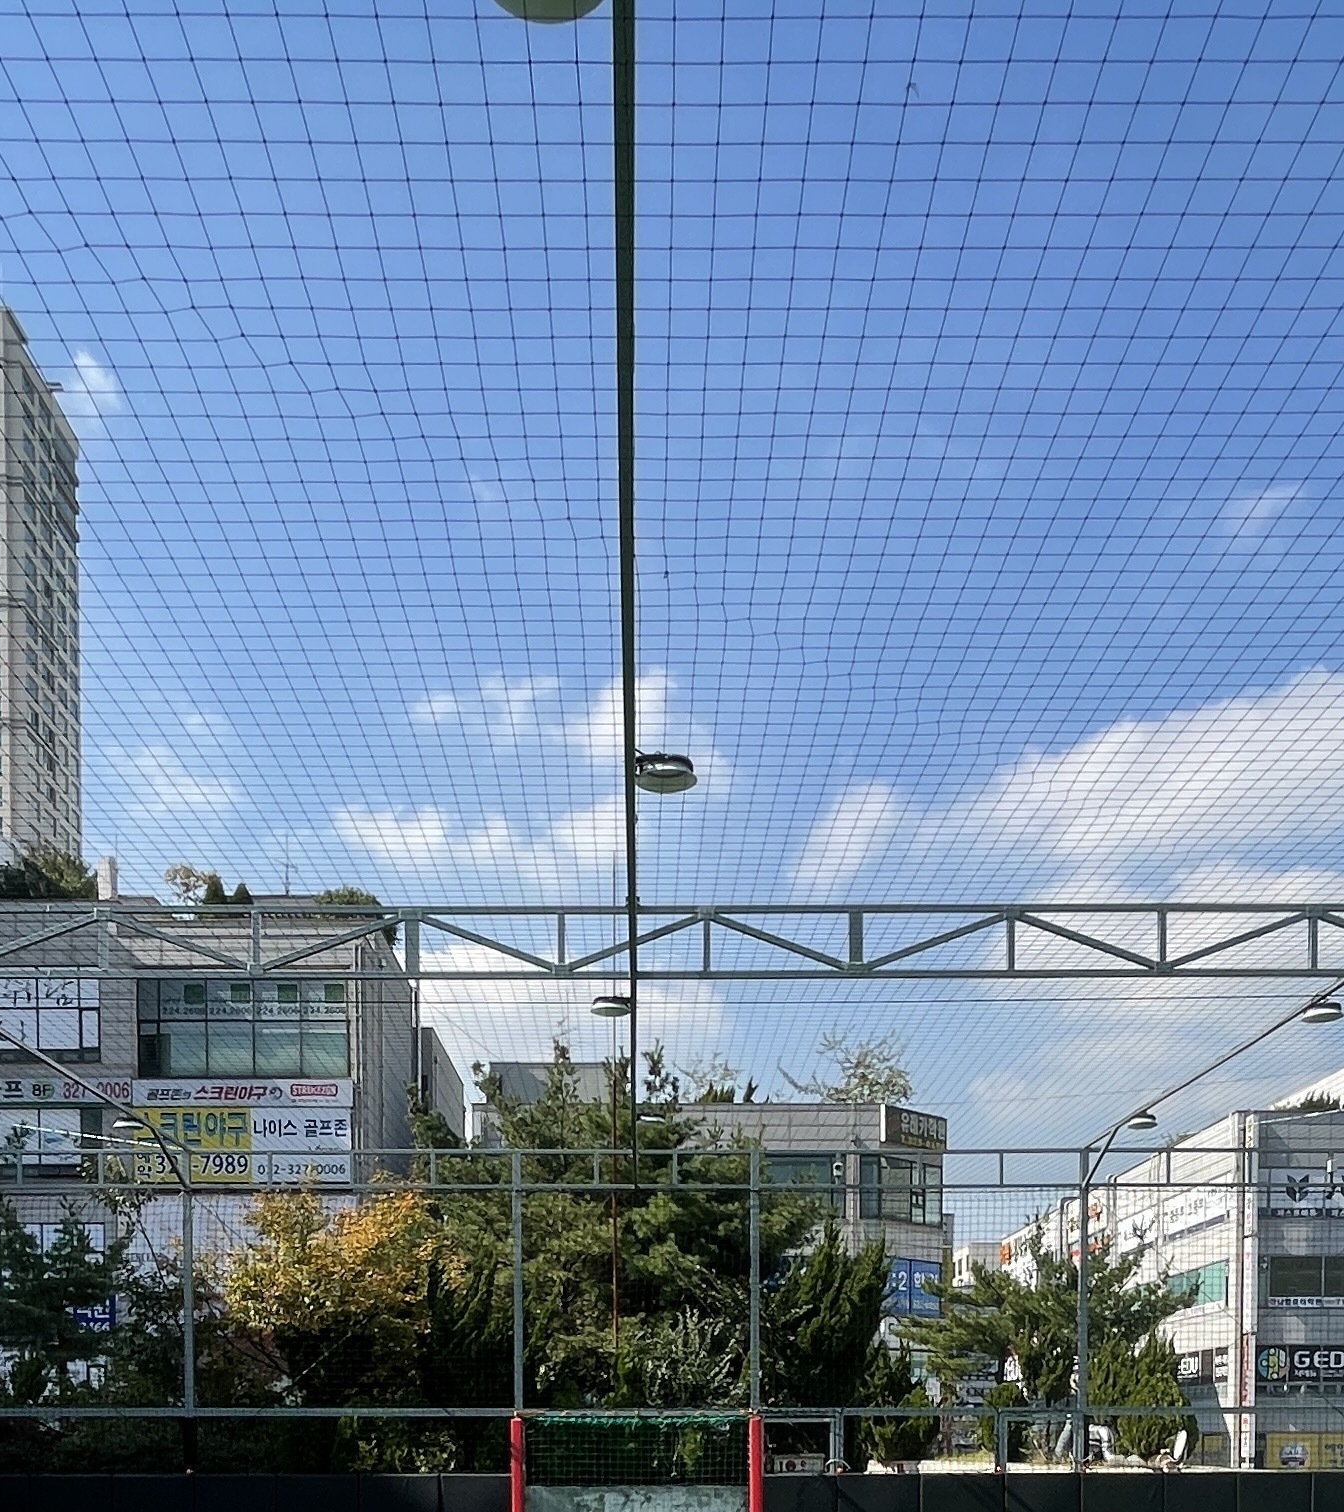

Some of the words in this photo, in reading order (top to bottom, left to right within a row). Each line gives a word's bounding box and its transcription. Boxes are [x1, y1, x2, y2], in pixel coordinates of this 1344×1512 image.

[193, 1085, 268, 1101] 스크린야구
[253, 1118, 297, 1138] 나이스
[304, 1118, 347, 1138] 골프존
[156, 1154, 248, 1174] 32-7989
